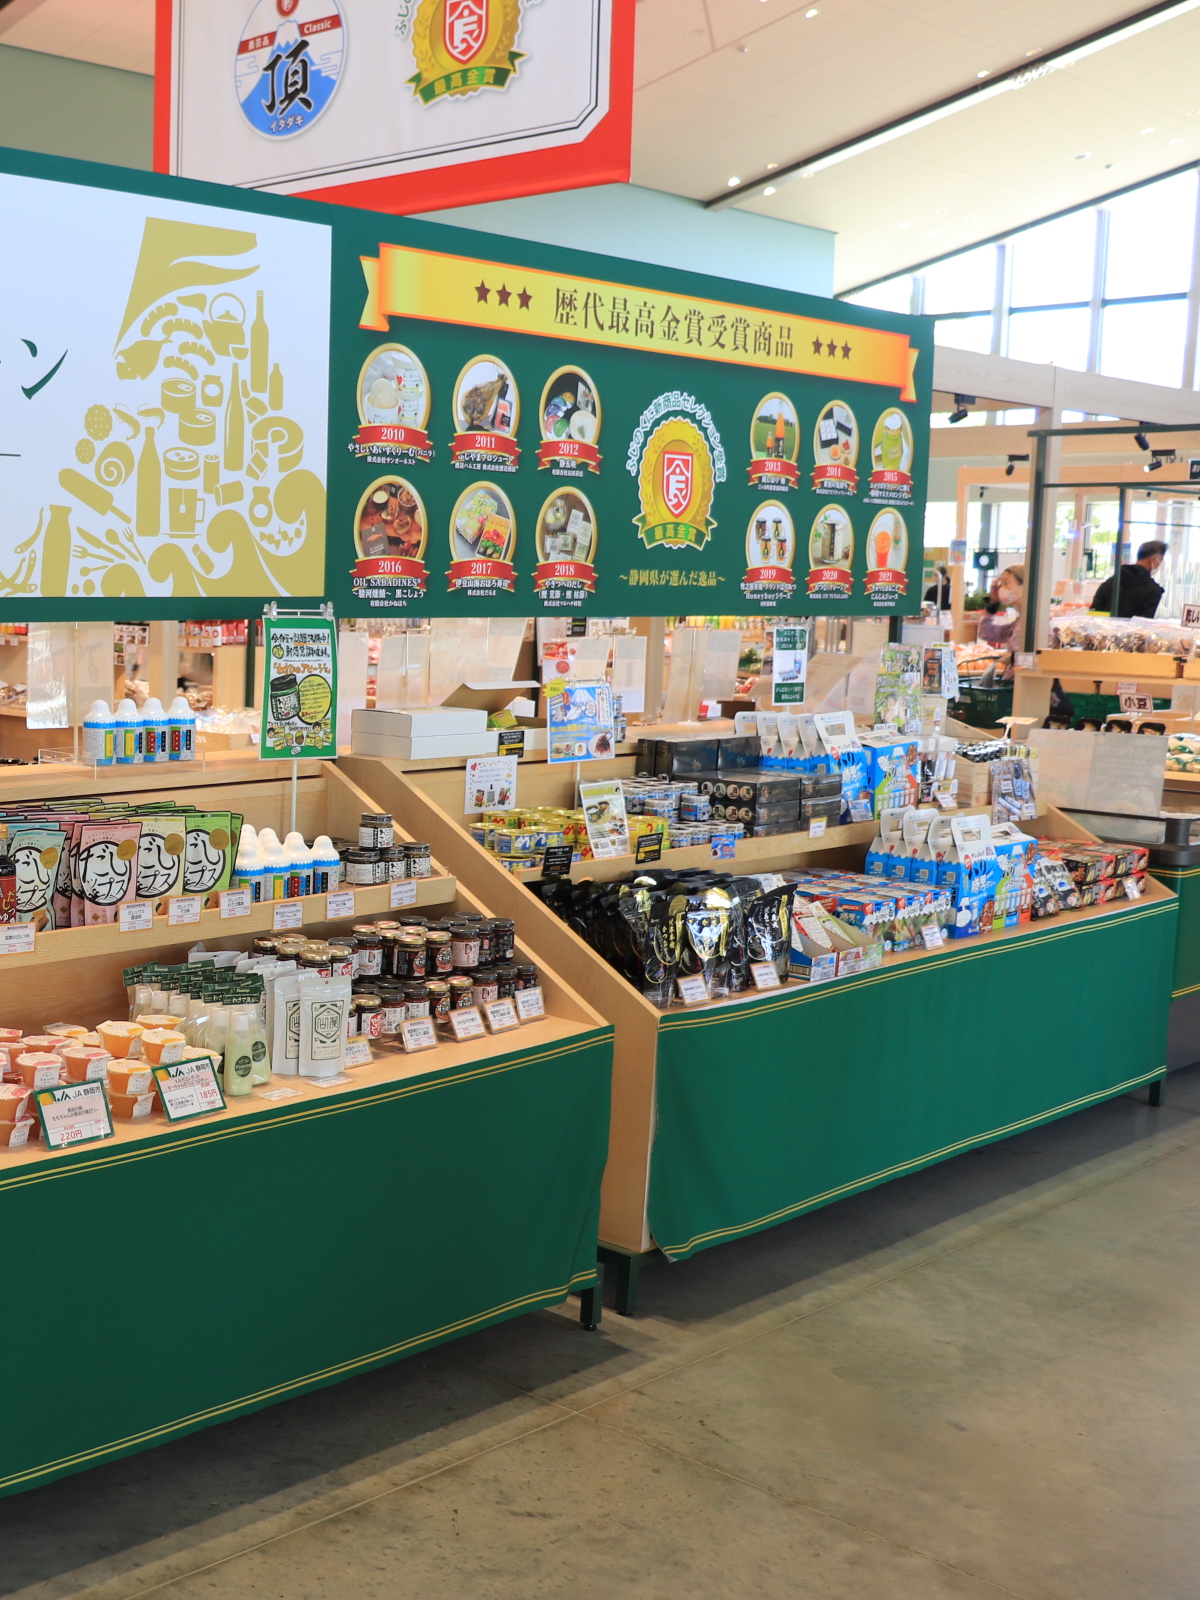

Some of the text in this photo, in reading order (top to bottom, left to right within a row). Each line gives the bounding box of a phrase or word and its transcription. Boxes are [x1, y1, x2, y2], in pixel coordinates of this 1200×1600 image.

[303, 18, 332, 34] Classic
[261, 39, 313, 118] 頂
[433, 67, 495, 96] 最高金賞
[269, 114, 304, 133] イタダキ
[553, 286, 794, 360] 歴代最高金賞受賞商品
[381, 427, 405, 441] 2010
[475, 435, 495, 448] 2011
[558, 443, 579, 455] 2012
[764, 461, 782, 472] 2013
[826, 466, 841, 477] 2014
[883, 471, 898, 482] 2015
[653, 522, 697, 541] 最高金賞
[378, 560, 402, 573] 2016
[471, 562, 492, 575] 2017
[554, 564, 575, 576] 2018
[759, 569, 777, 579] 2019
[822, 570, 838, 581] 2020
[878, 571, 893, 581] 2021
[353, 577, 368, 586] OIL
[1125, 696, 1149, 709] 小豆
[199, 1089, 218, 1099] 185円
[60, 1130, 83, 1142] 220円
